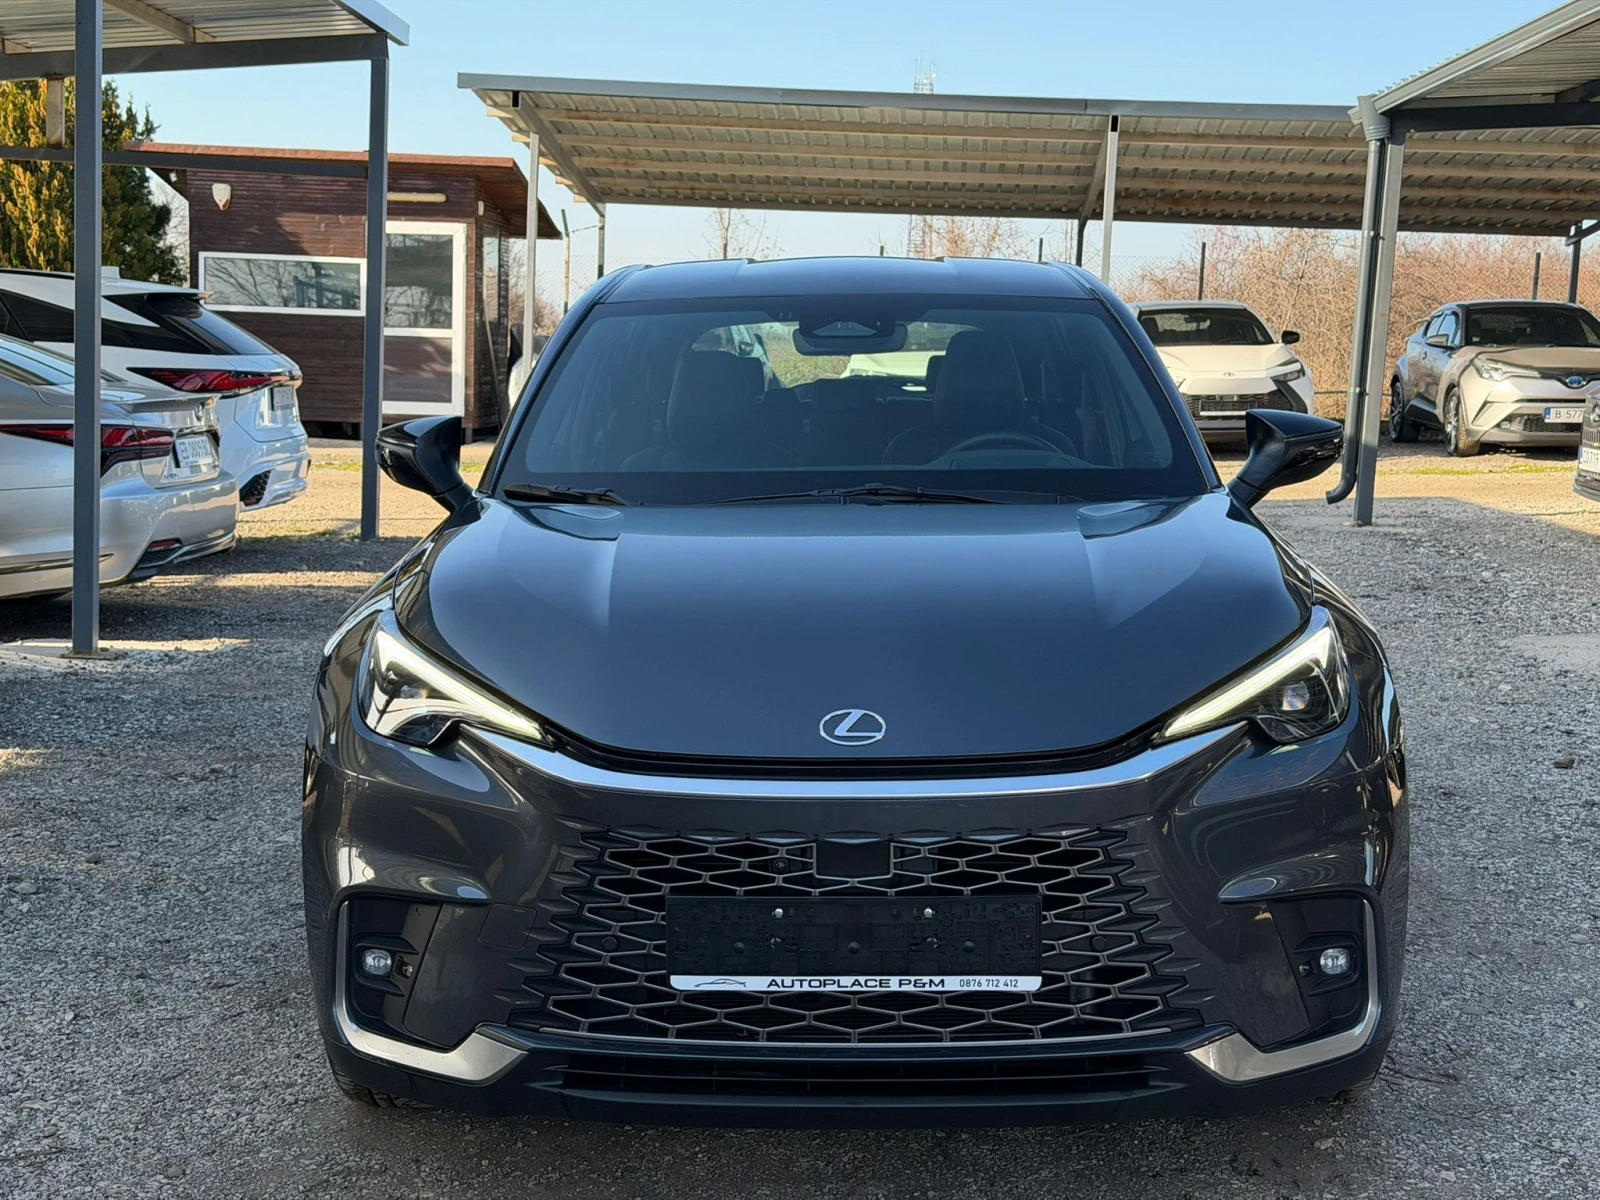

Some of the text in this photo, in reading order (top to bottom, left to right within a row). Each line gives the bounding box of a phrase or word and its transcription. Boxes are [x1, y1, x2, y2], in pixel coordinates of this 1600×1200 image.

[1555, 410, 1561, 419] B
[766, 978, 1019, 989] AUTOPLACE P&M 0876 712 412
